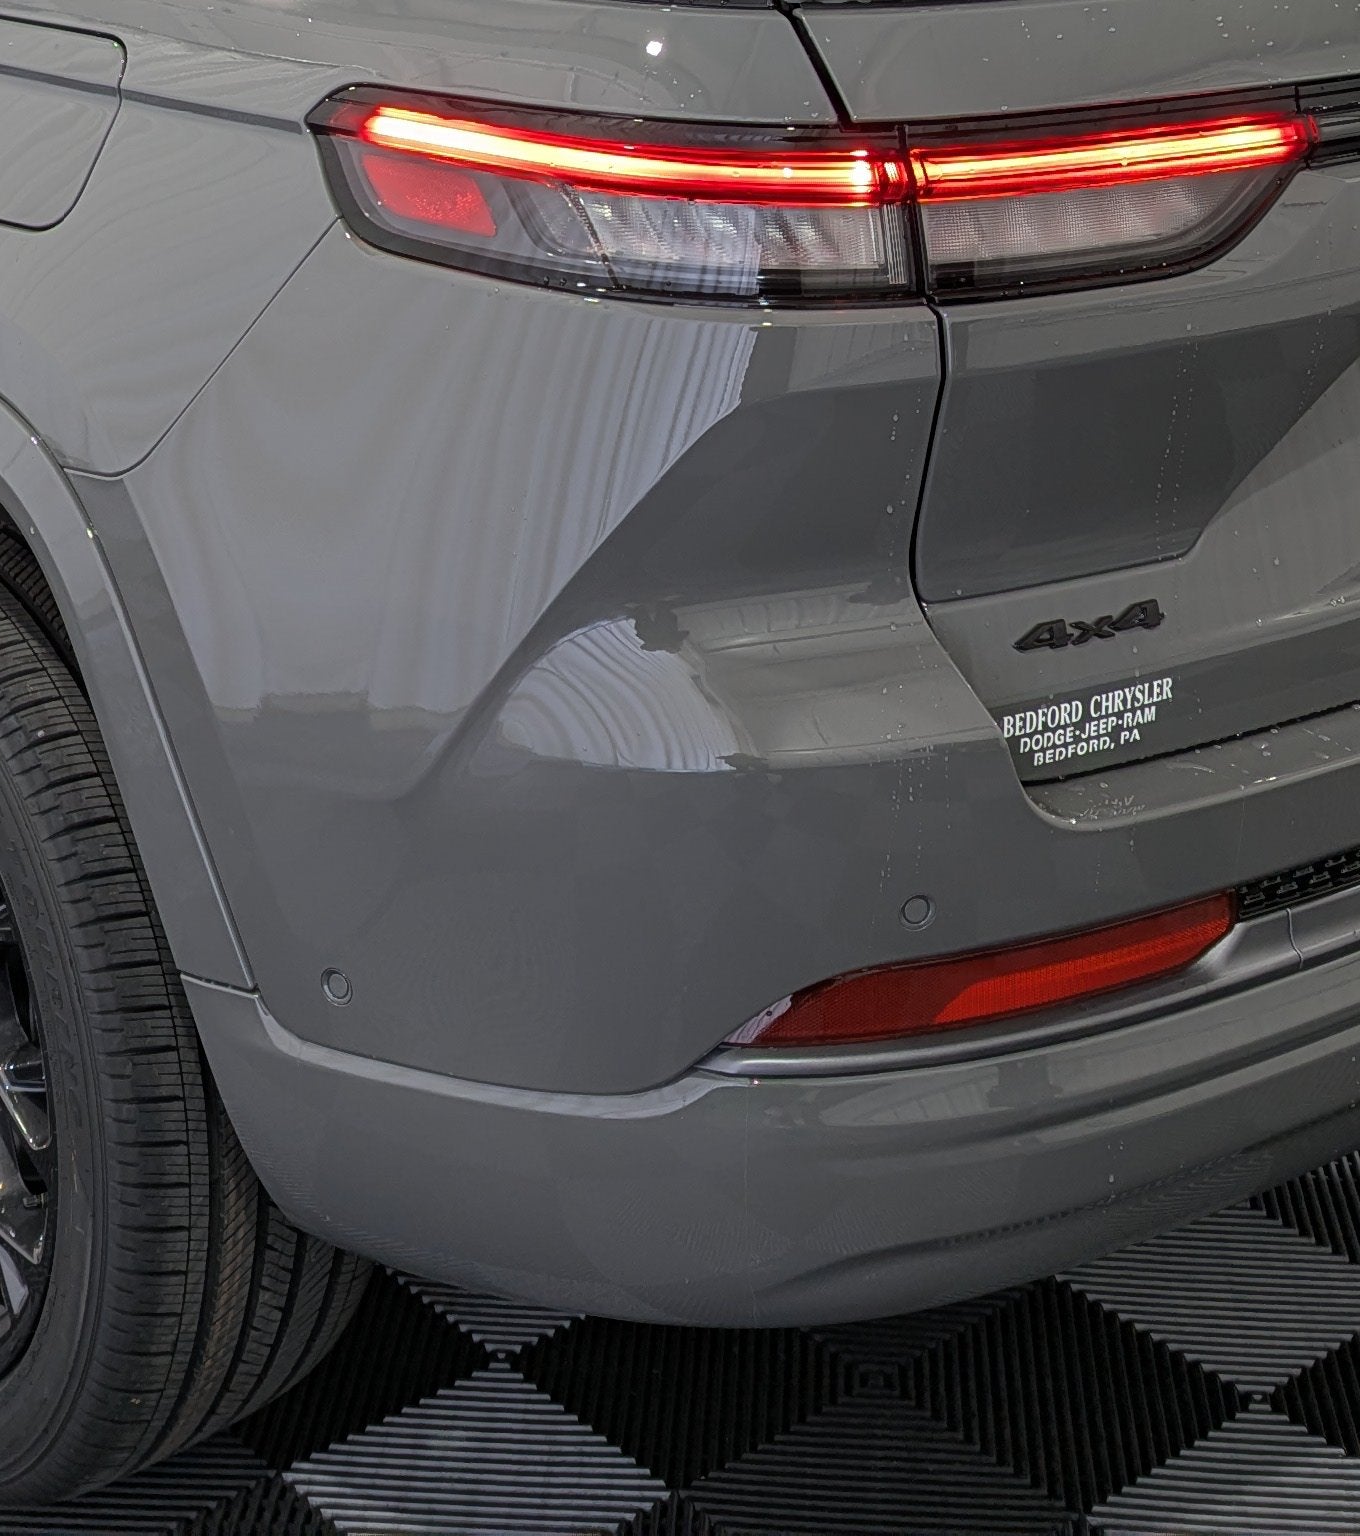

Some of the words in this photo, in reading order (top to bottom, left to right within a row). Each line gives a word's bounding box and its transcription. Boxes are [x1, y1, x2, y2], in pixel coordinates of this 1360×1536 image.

[1013, 599, 1166, 652] 4x4
[1002, 700, 1084, 739] BEDFORD
[1090, 677, 1173, 717] CHRYSLER
[1034, 737, 1115, 766] BEDFORD,
[1120, 729, 1141, 745] PA
